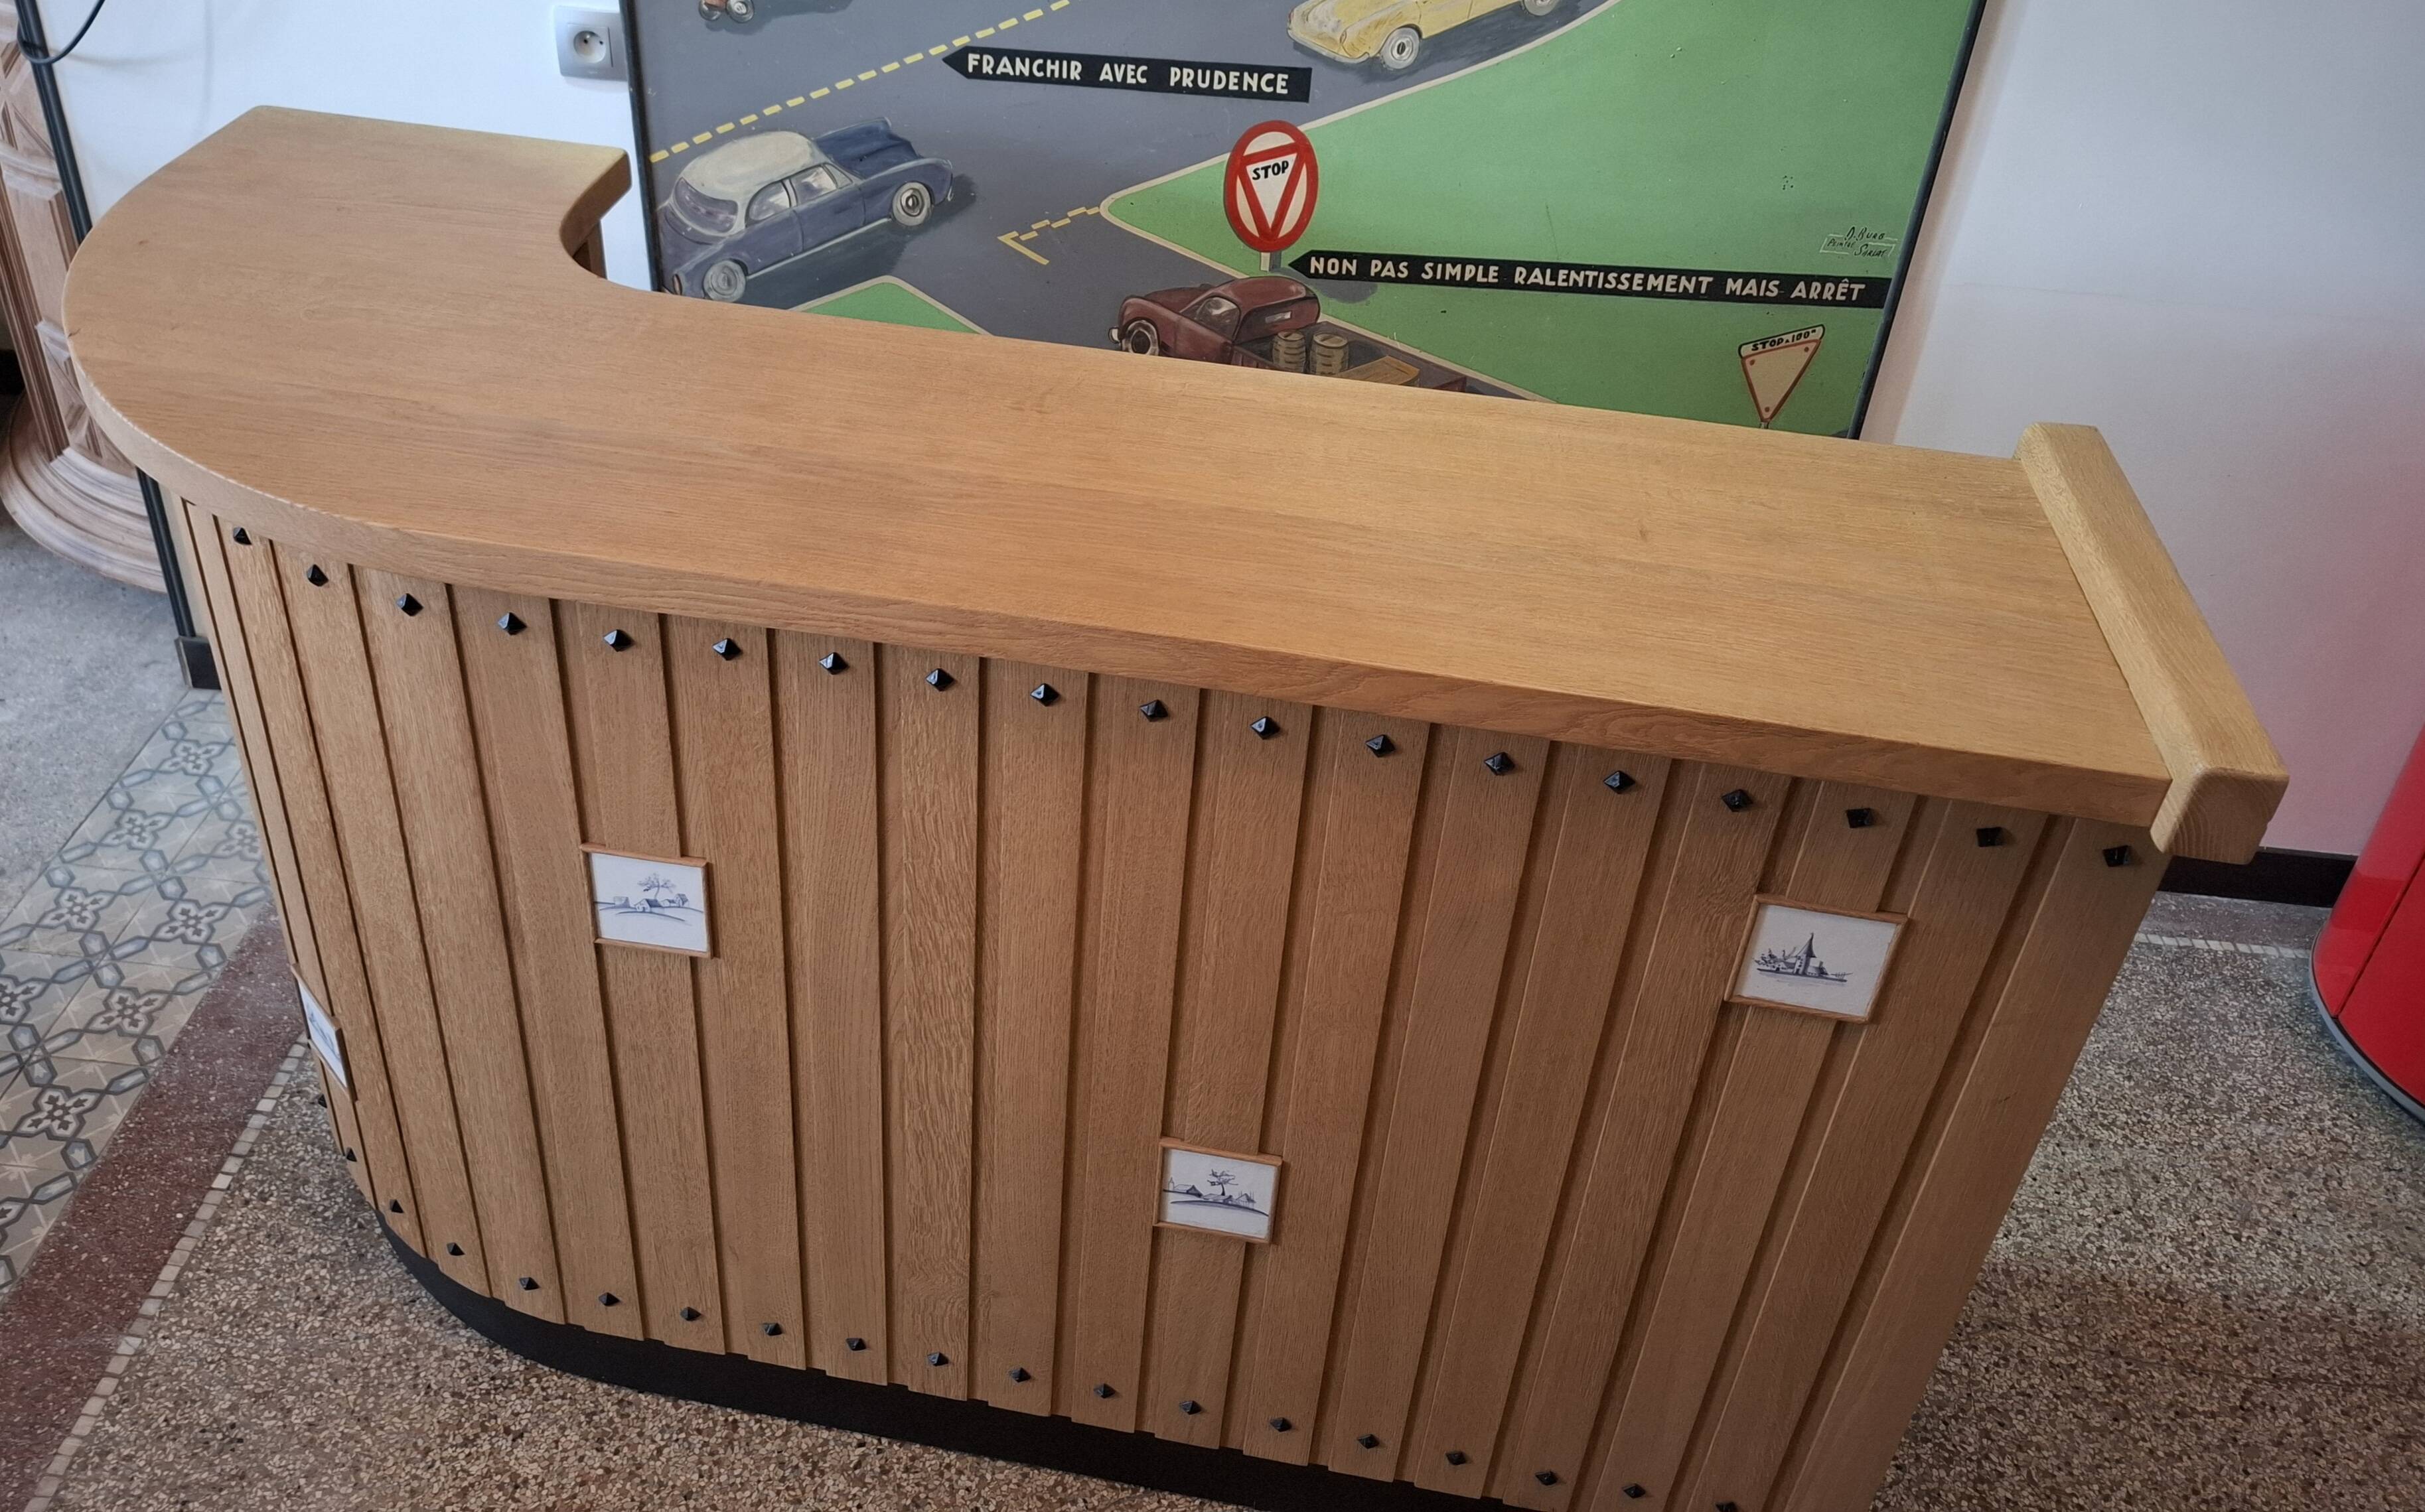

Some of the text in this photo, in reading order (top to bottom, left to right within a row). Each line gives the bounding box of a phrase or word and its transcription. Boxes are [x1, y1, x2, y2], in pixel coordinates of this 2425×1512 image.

[967, 53, 1289, 94] FRANCHIR AVEC PRUDENCE
[1252, 161, 1289, 180] STOP
[1310, 257, 1866, 301] NON PAS SIMPLE RALENTISSEMENT MAIS ARRÊT
[1751, 338, 1784, 351] STOP
